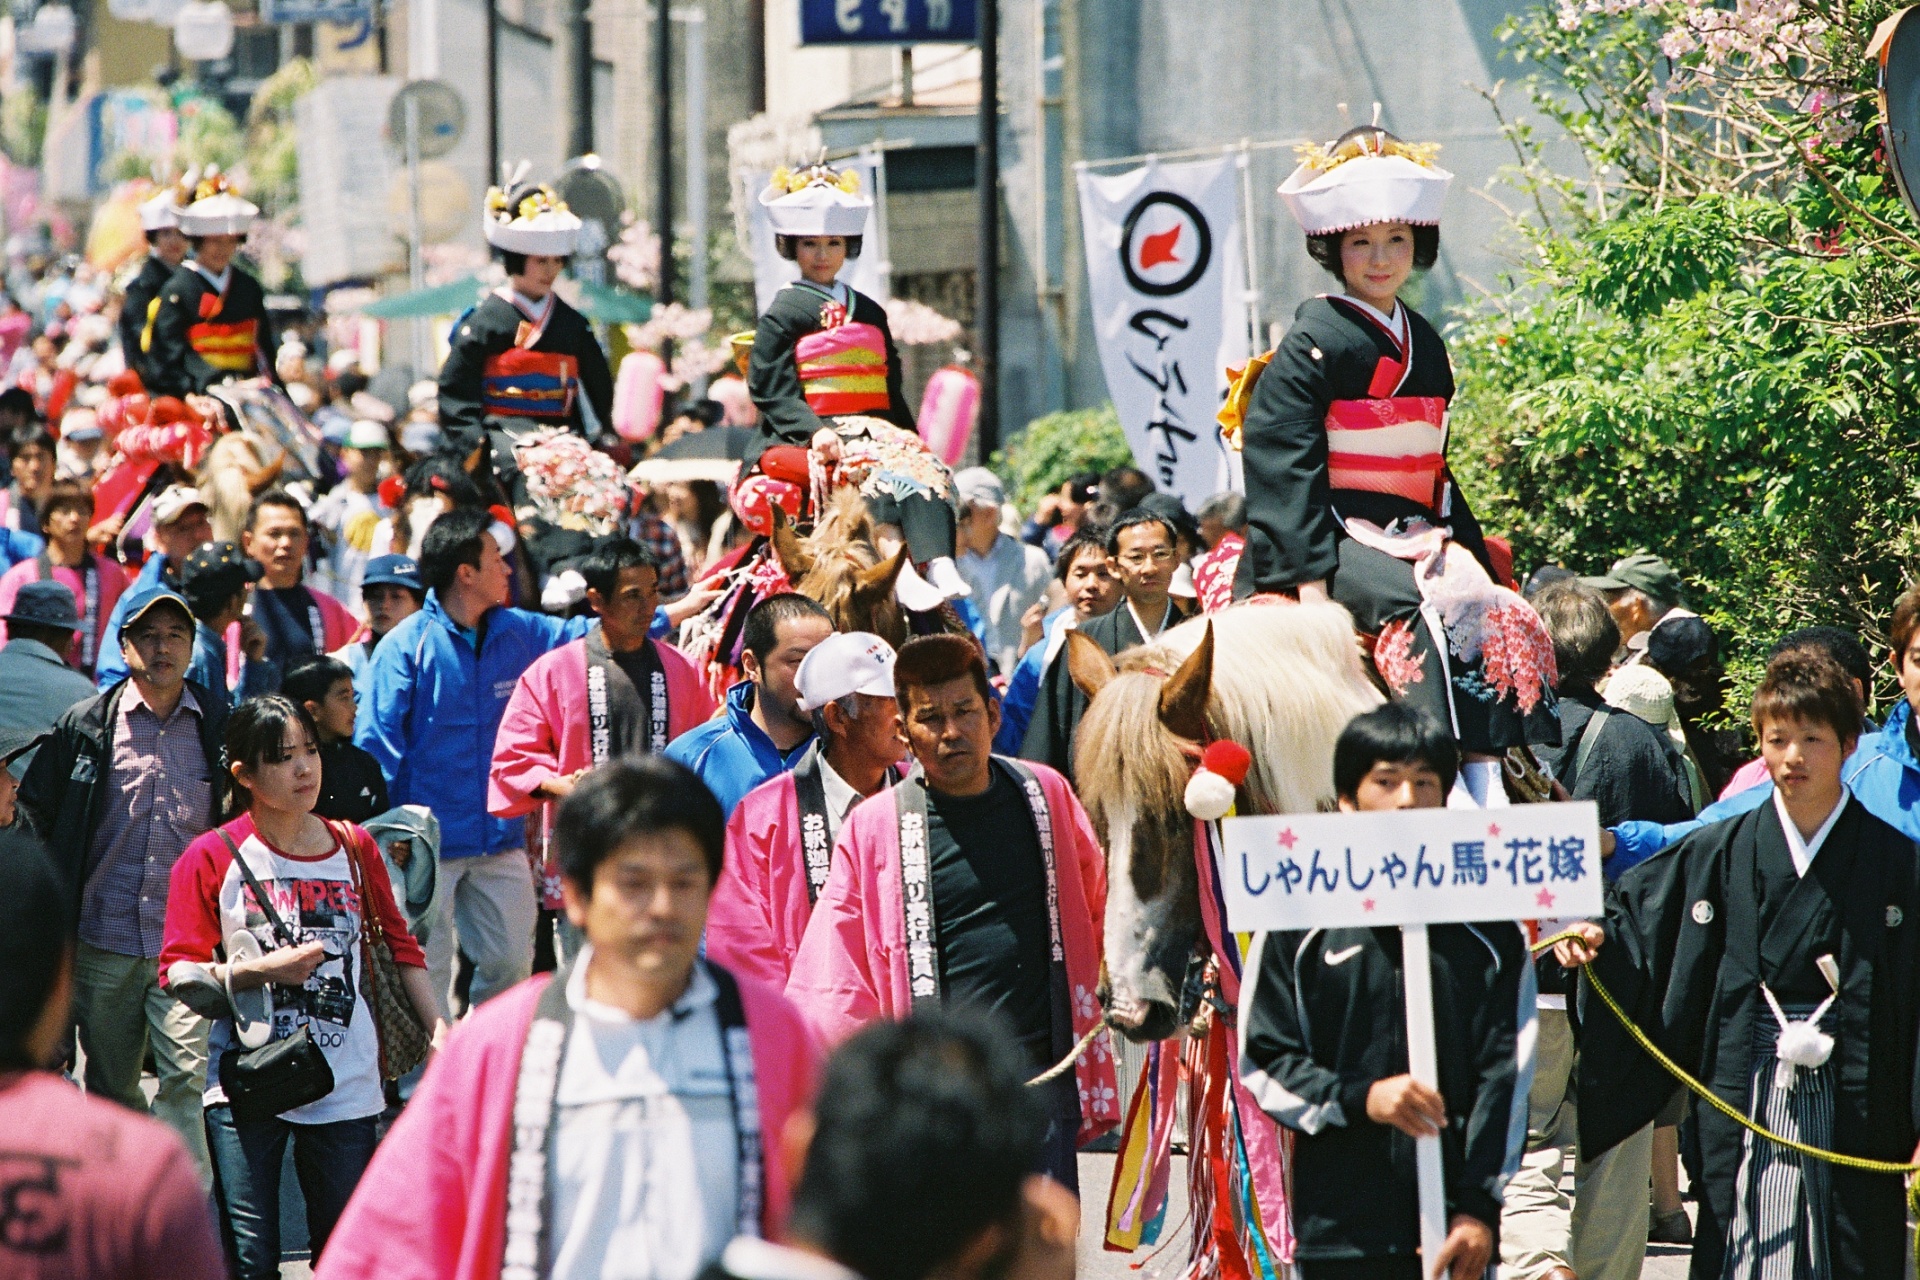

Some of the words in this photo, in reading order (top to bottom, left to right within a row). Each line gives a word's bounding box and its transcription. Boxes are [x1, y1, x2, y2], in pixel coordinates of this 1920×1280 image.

[900, 812, 935, 997] お釈迦祭り実行委員会
[1241, 836, 1587, 896] しゃんしゃん馬・花嫁
